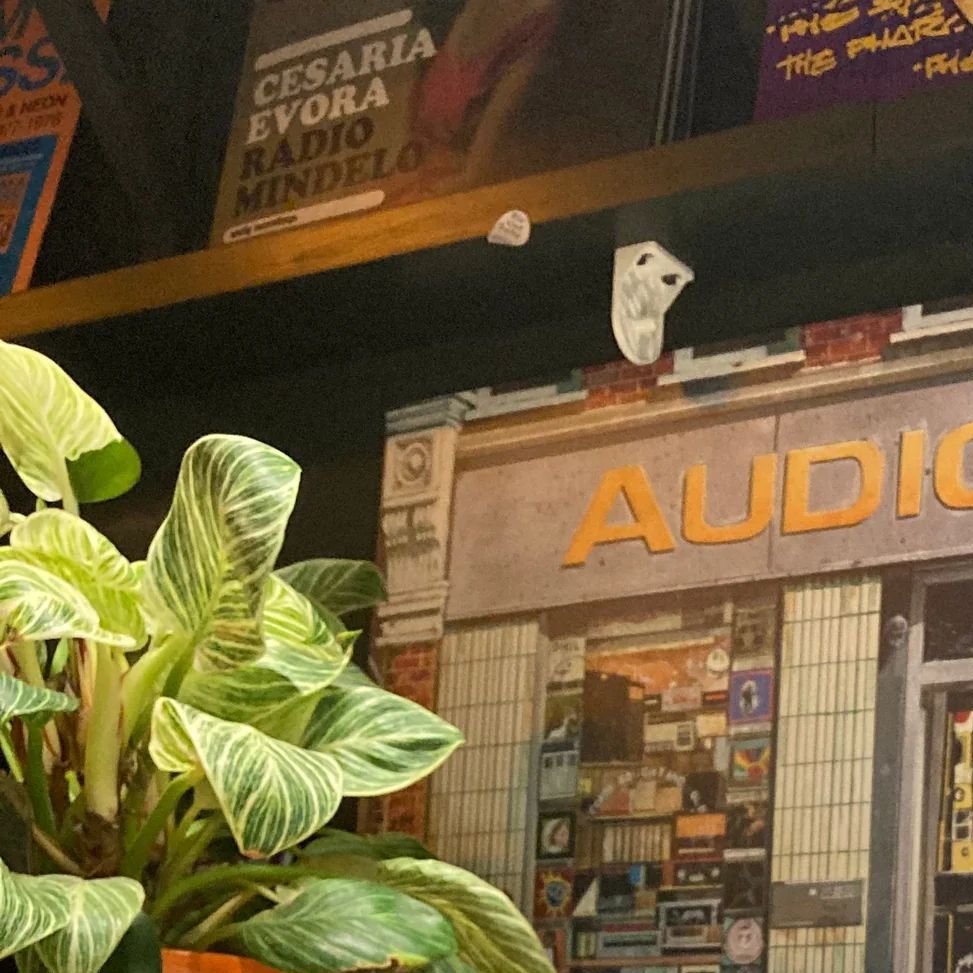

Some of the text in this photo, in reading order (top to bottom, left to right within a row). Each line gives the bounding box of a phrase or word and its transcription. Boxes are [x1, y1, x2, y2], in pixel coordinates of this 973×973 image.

[253, 28, 438, 106] CESARIA
[246, 77, 390, 145] EVORA
[232, 141, 427, 218] MINDELO
[241, 117, 376, 182] RADIO
